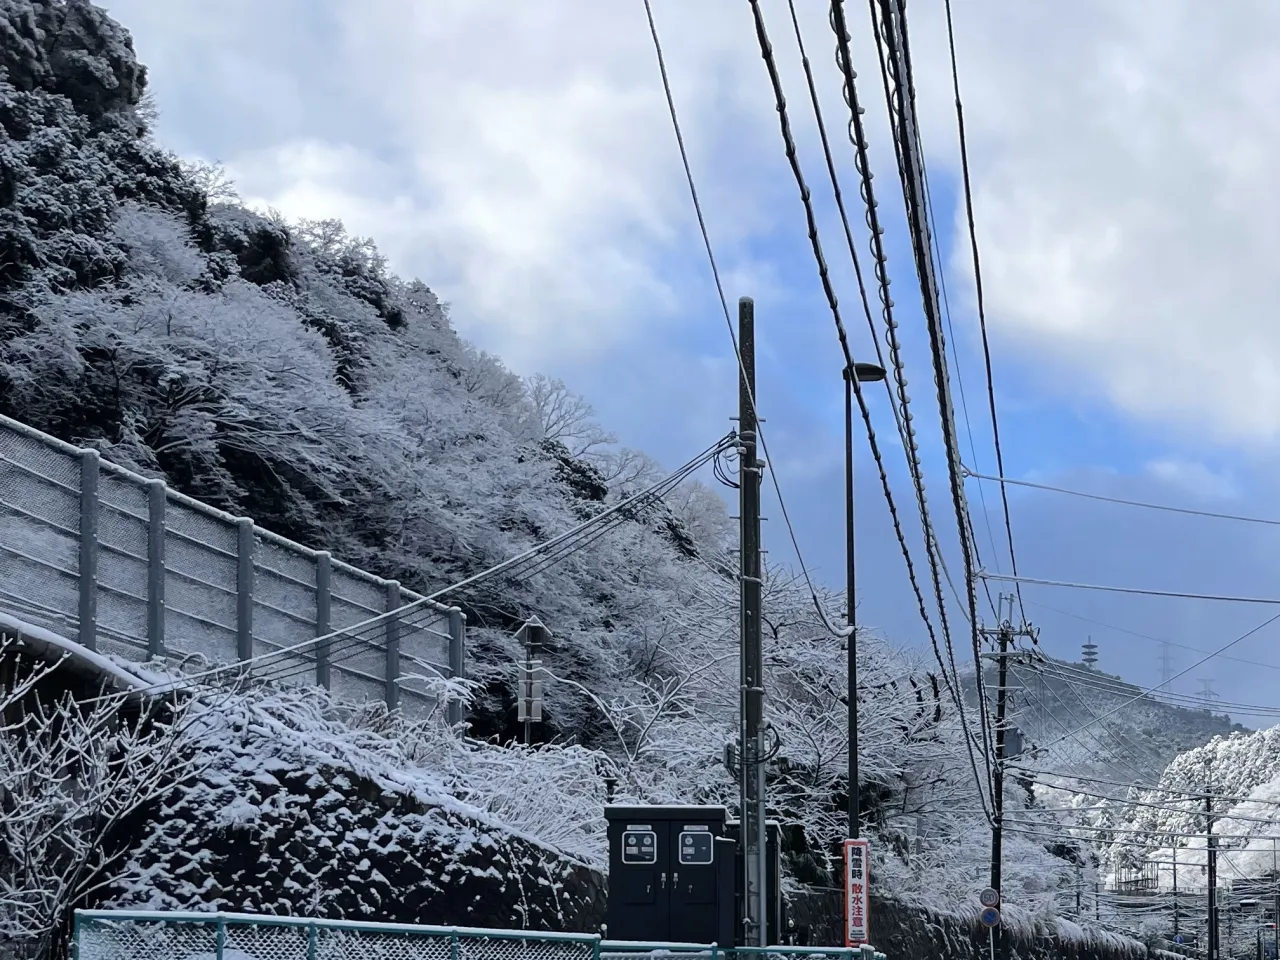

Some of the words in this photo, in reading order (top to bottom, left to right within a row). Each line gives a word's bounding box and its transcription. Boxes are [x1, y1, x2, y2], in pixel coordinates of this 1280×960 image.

[851, 847, 863, 880] 降雪時
[851, 883, 863, 928] 散水注意
[983, 893, 995, 903] 50
